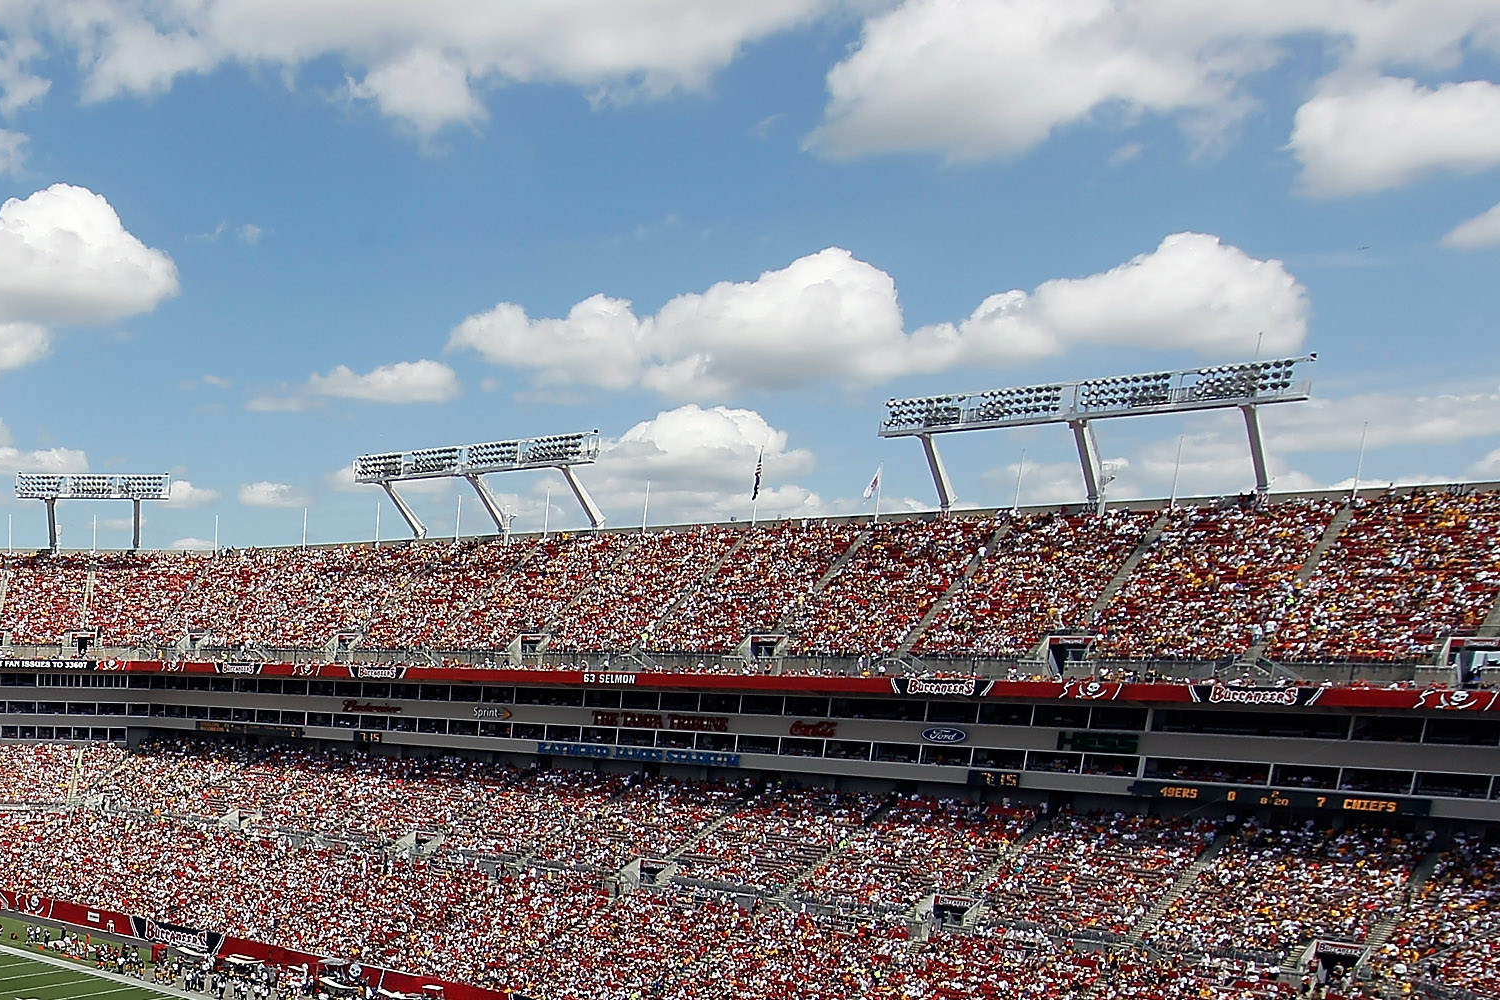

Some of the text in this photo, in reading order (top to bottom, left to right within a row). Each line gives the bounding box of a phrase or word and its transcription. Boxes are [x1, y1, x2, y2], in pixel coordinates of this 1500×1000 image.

[22, 660, 50, 668] ISSUES
[584, 674, 636, 684] 63 SELMON
[342, 700, 402, 713] Budweiser
[473, 706, 498, 718] Sprint
[592, 711, 729, 732] THE TAMPA TRIBUNE
[789, 720, 838, 738] Coca-Cola
[930, 729, 958, 740] Ford
[1057, 732, 1140, 754] HESS
[537, 742, 740, 766] RAYMOND JAMES STADIUM
[981, 772, 1017, 786] 7:15
[1160, 786, 1280, 801] 49ERS 0 2
[1316, 797, 1326, 807] 7
[1342, 798, 1397, 812] CHIEFS
